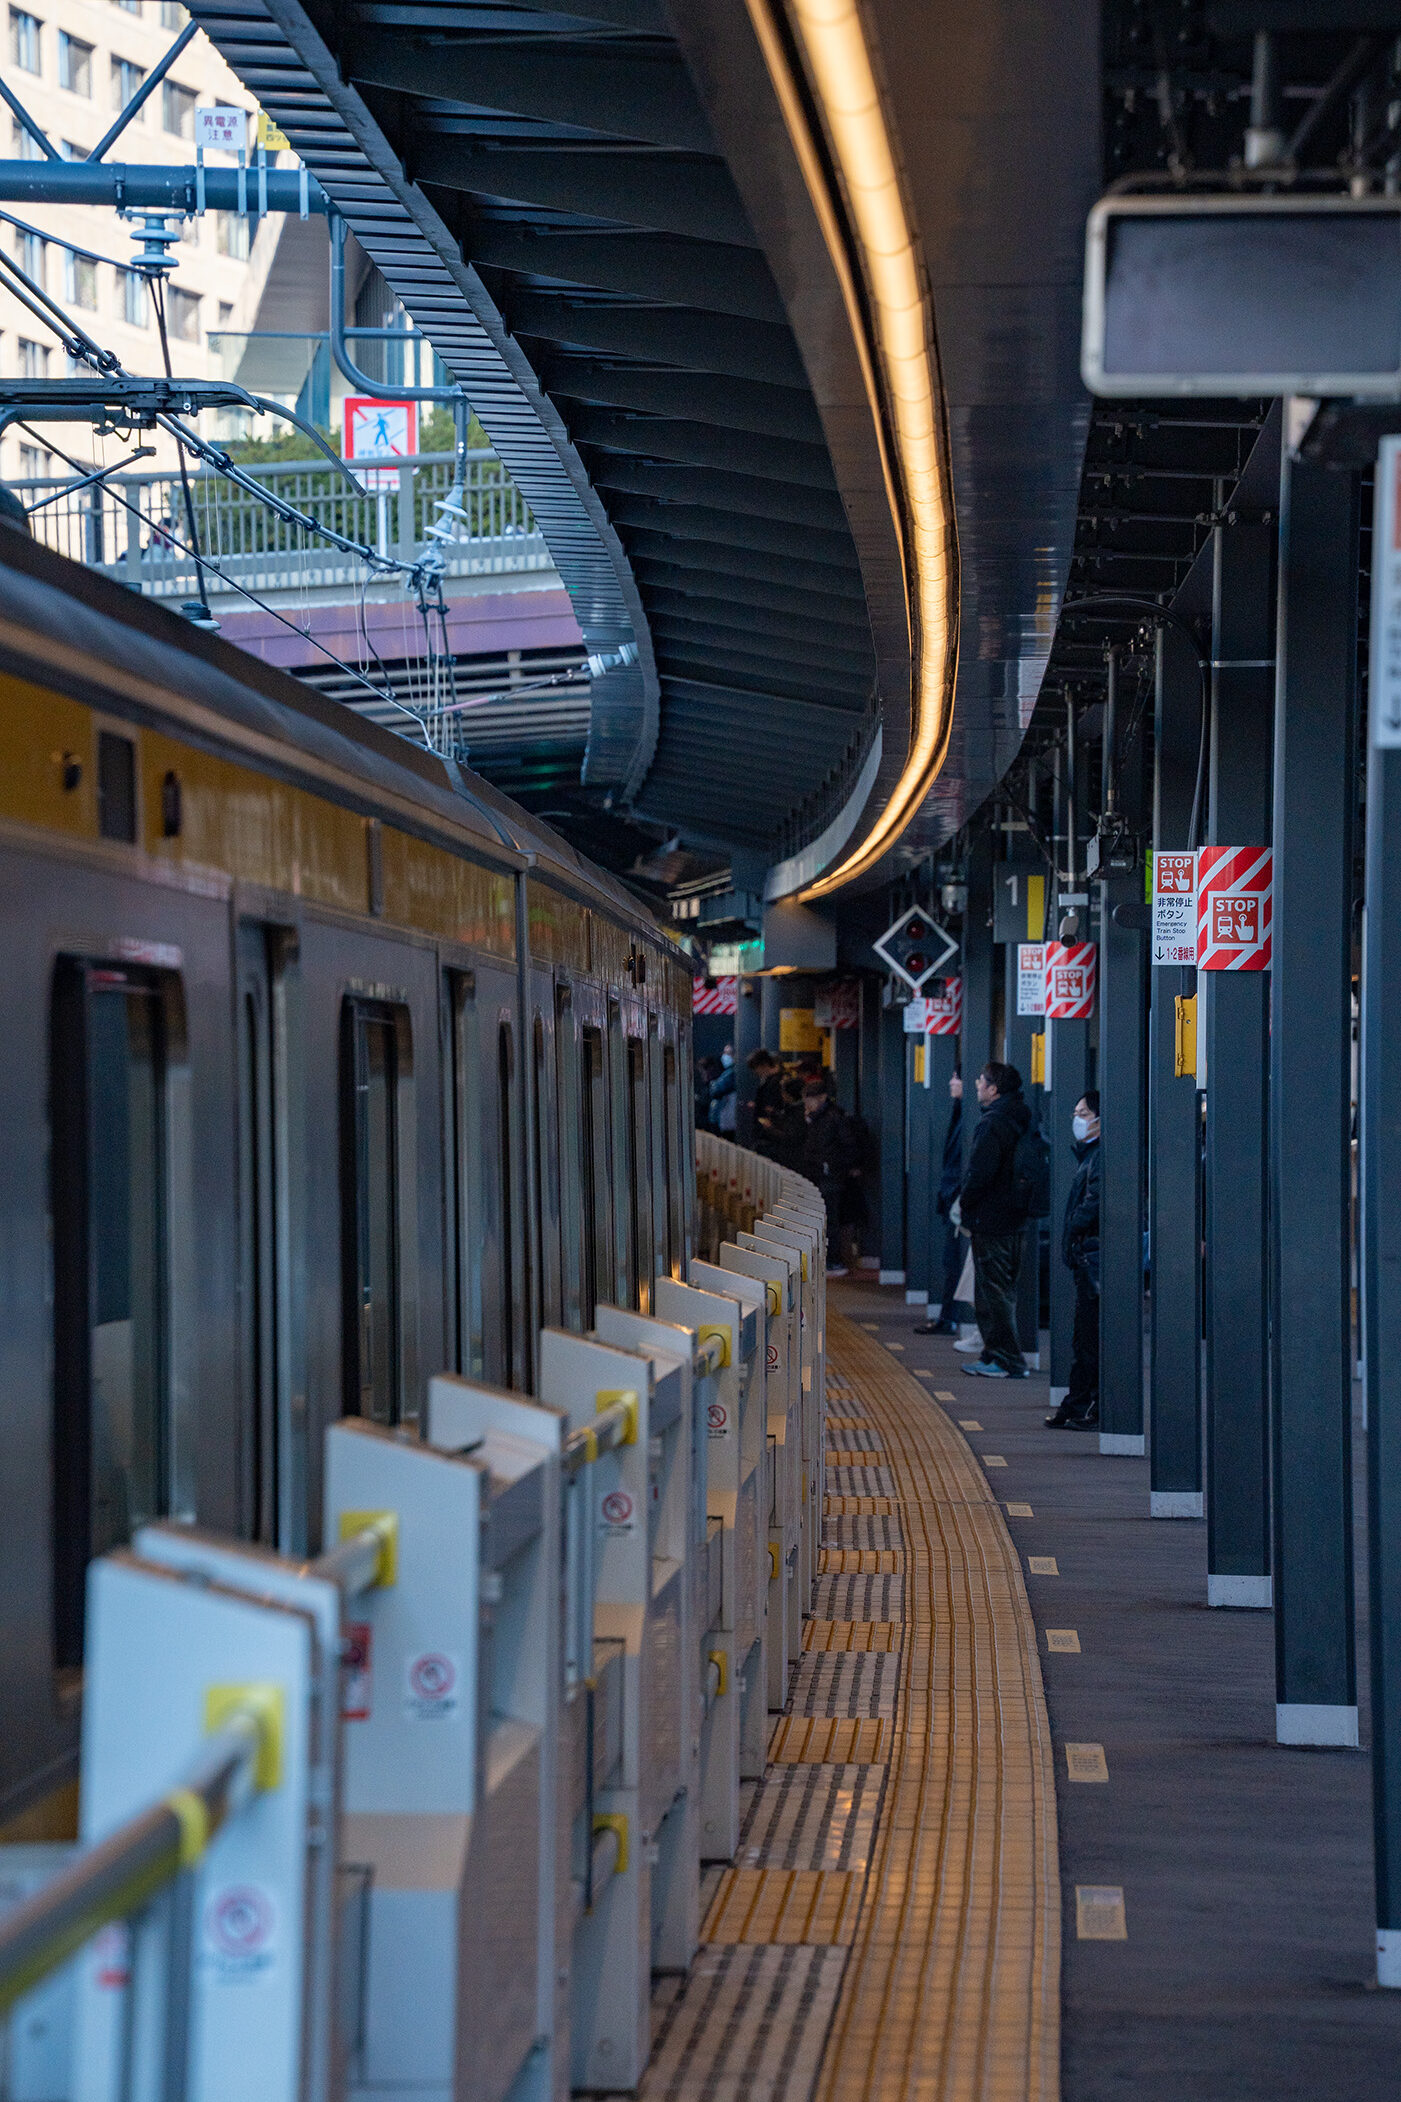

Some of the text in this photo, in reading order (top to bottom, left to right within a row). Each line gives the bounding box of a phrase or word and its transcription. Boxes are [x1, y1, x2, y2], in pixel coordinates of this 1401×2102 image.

[203, 115, 238, 128] 異電源
[208, 129, 233, 142] 注意
[1160, 858, 1192, 868] STOP
[1006, 875, 1017, 906] 1
[1157, 897, 1193, 908] 非常停止
[1215, 900, 1257, 912] STOP
[1157, 909, 1184, 920] ボタン
[1156, 920, 1188, 928] Emergency
[1056, 971, 1082, 980] STOP
